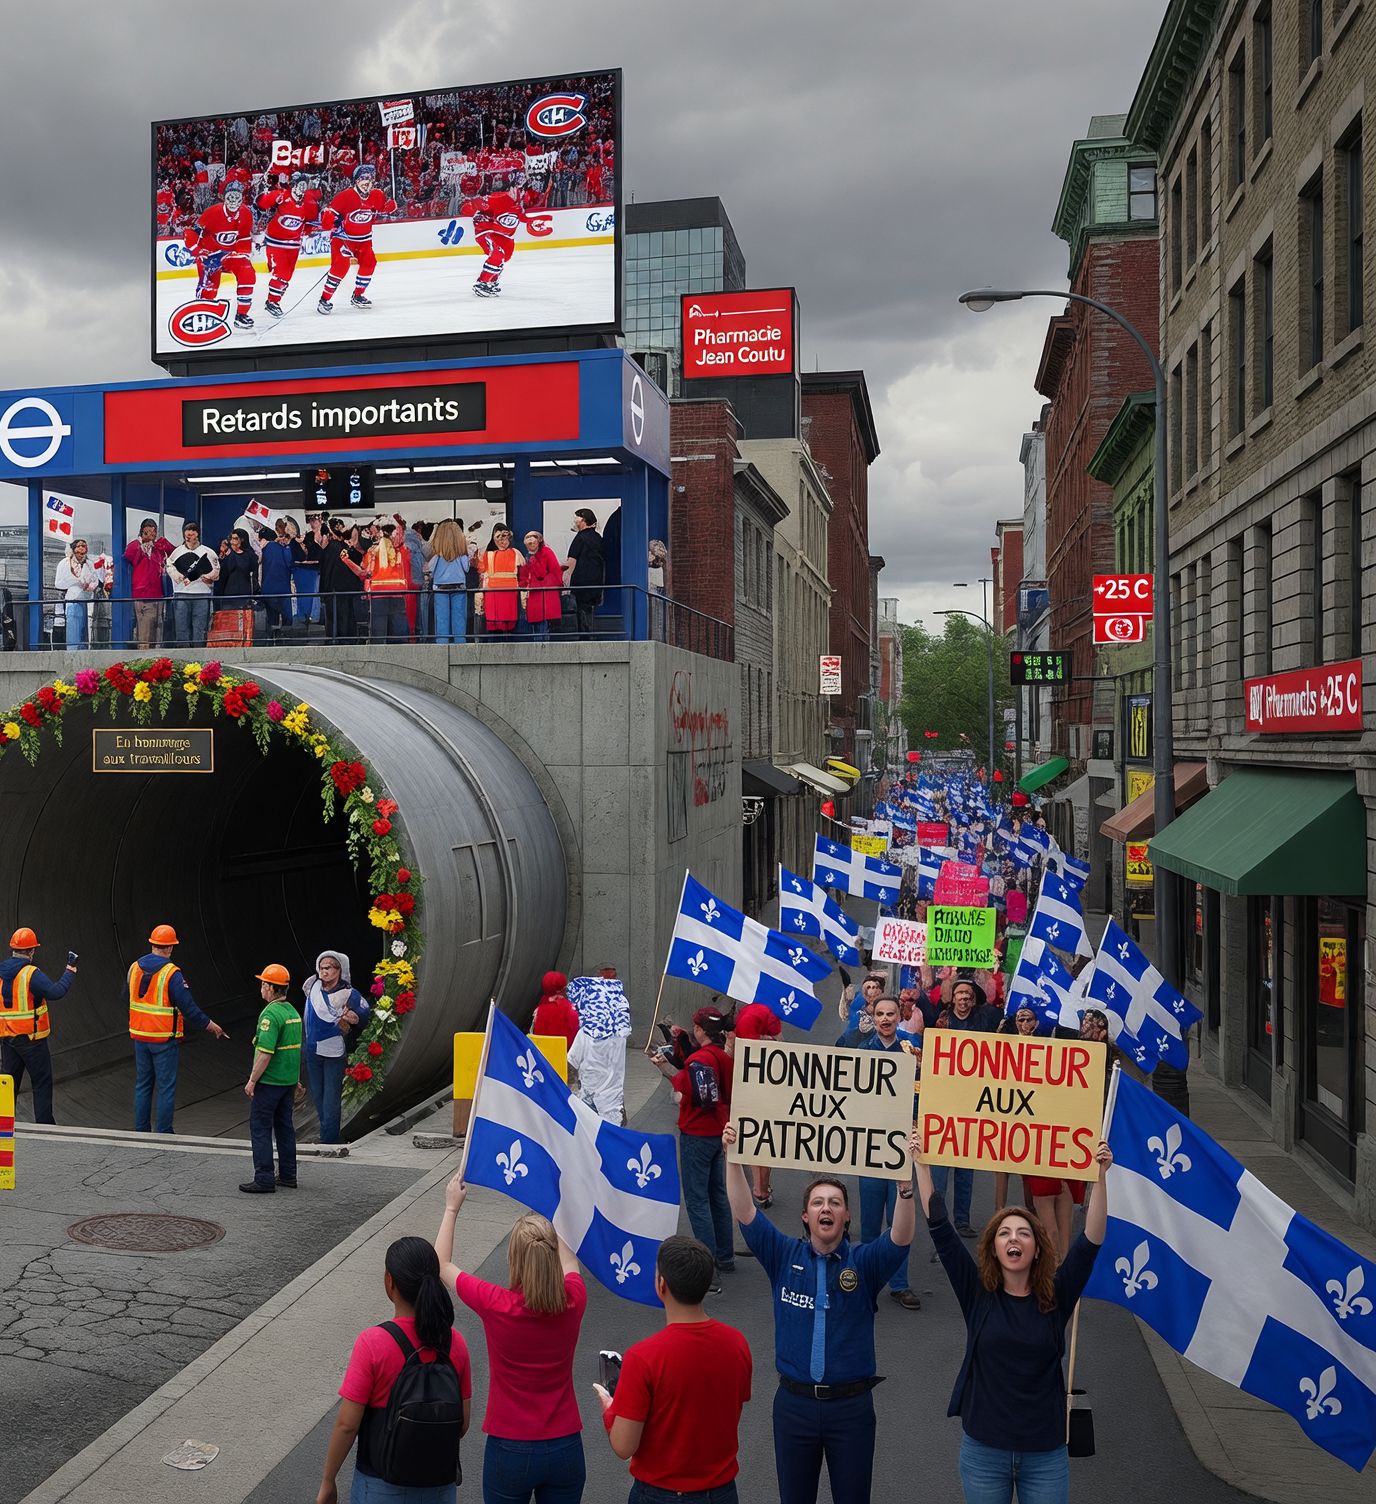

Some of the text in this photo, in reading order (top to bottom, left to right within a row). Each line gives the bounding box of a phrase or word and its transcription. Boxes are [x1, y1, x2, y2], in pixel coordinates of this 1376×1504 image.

[694, 325, 782, 345] Pharmacie
[695, 346, 786, 365] Jean Coutu
[202, 397, 459, 434] Retards importants
[743, 1046, 897, 1097] HONNEUR
[933, 1036, 1090, 1089] HONNEUR
[789, 1092, 847, 1121] AUX
[975, 1086, 1035, 1116] AUX
[738, 1117, 907, 1170] PATRIOTES
[924, 1113, 1094, 1170] PATRIOTES
